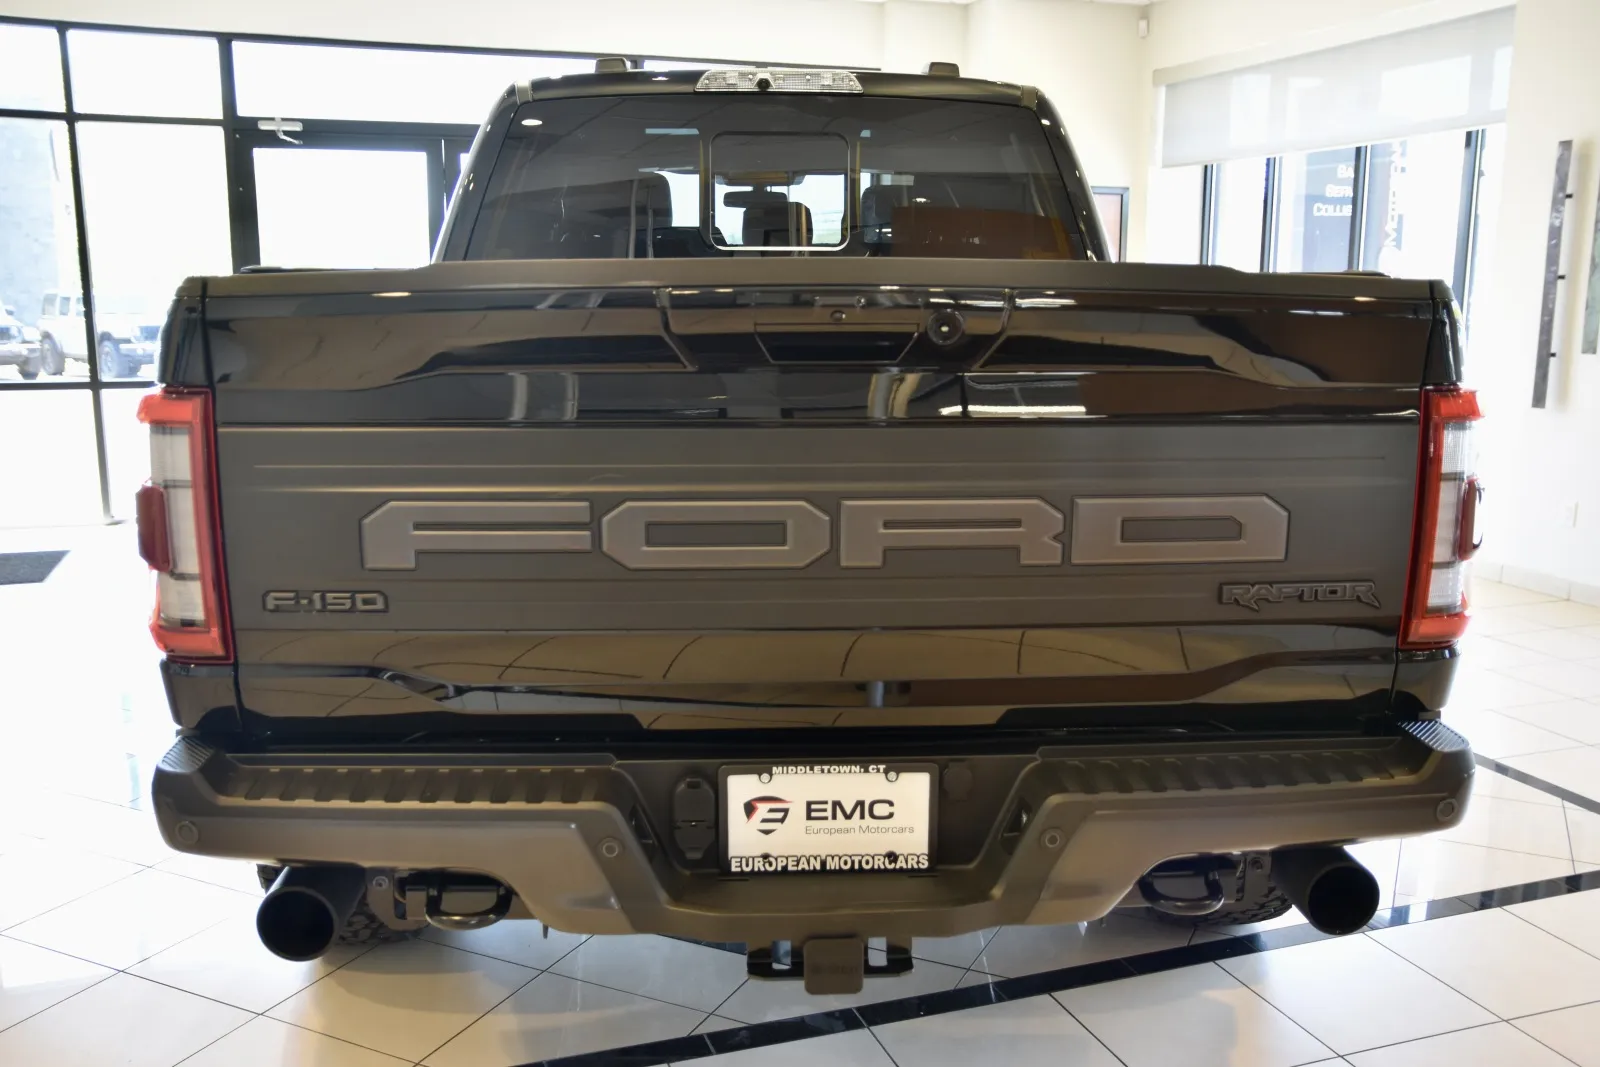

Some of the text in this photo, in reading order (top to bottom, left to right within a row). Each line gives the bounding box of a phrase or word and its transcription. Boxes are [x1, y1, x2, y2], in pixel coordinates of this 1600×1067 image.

[361, 493, 1290, 571] FORD
[264, 590, 388, 612] F-150
[1219, 580, 1381, 612] RAPTOR
[868, 764, 886, 773] CT
[805, 799, 895, 821] EMC
[805, 824, 915, 837] European Motorcars
[730, 854, 929, 872] EUROPEAN MOTORCARS
